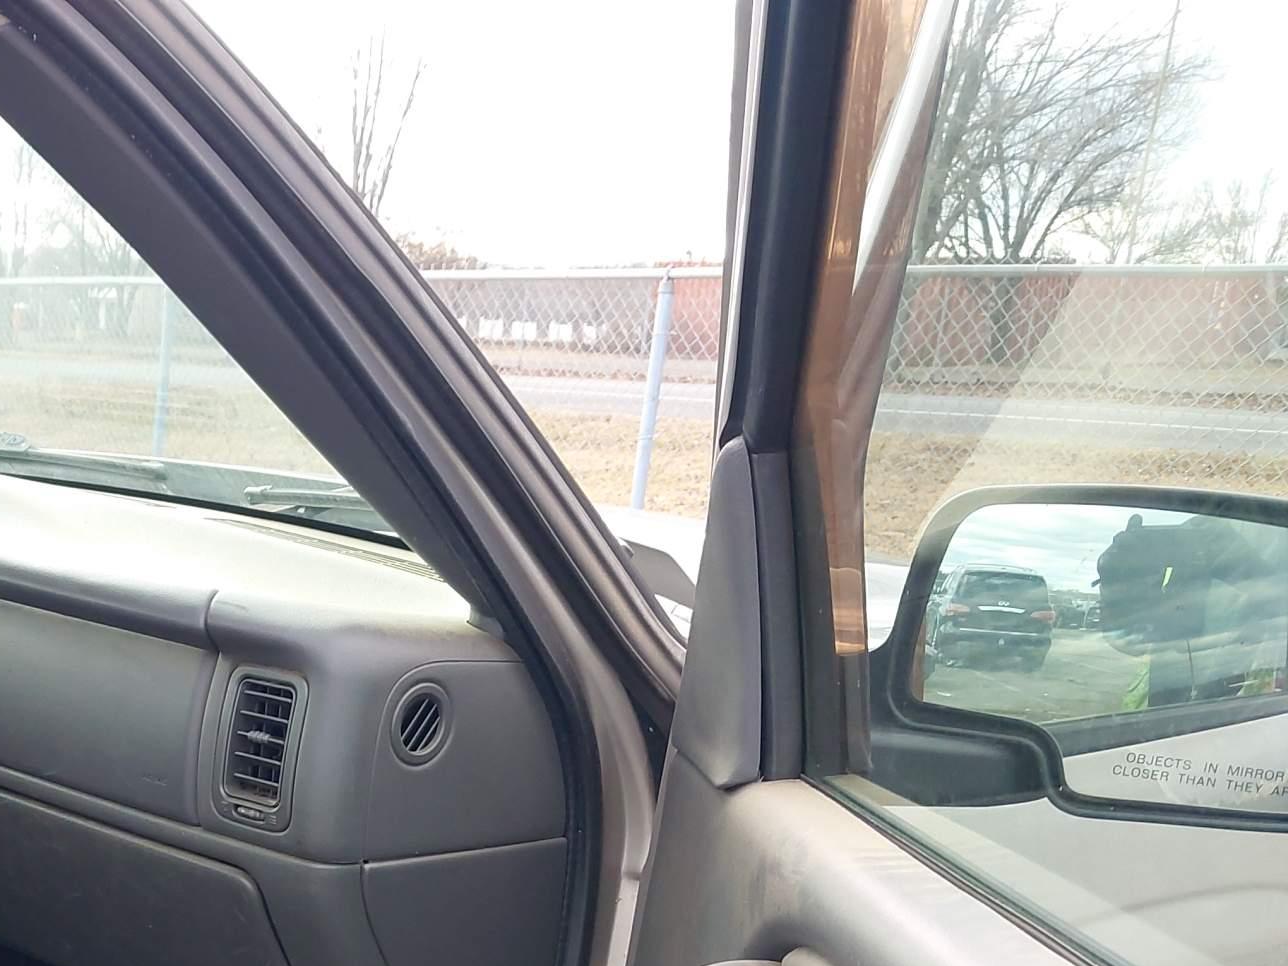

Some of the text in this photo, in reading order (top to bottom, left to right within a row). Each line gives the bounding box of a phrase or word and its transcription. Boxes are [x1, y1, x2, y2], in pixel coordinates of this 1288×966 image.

[1112, 764, 1169, 782] CLOSER
[1178, 773, 1216, 788] THAN
[1226, 779, 1263, 793] THEY
[1126, 752, 1285, 781] OBJECTS IN MIRROR
